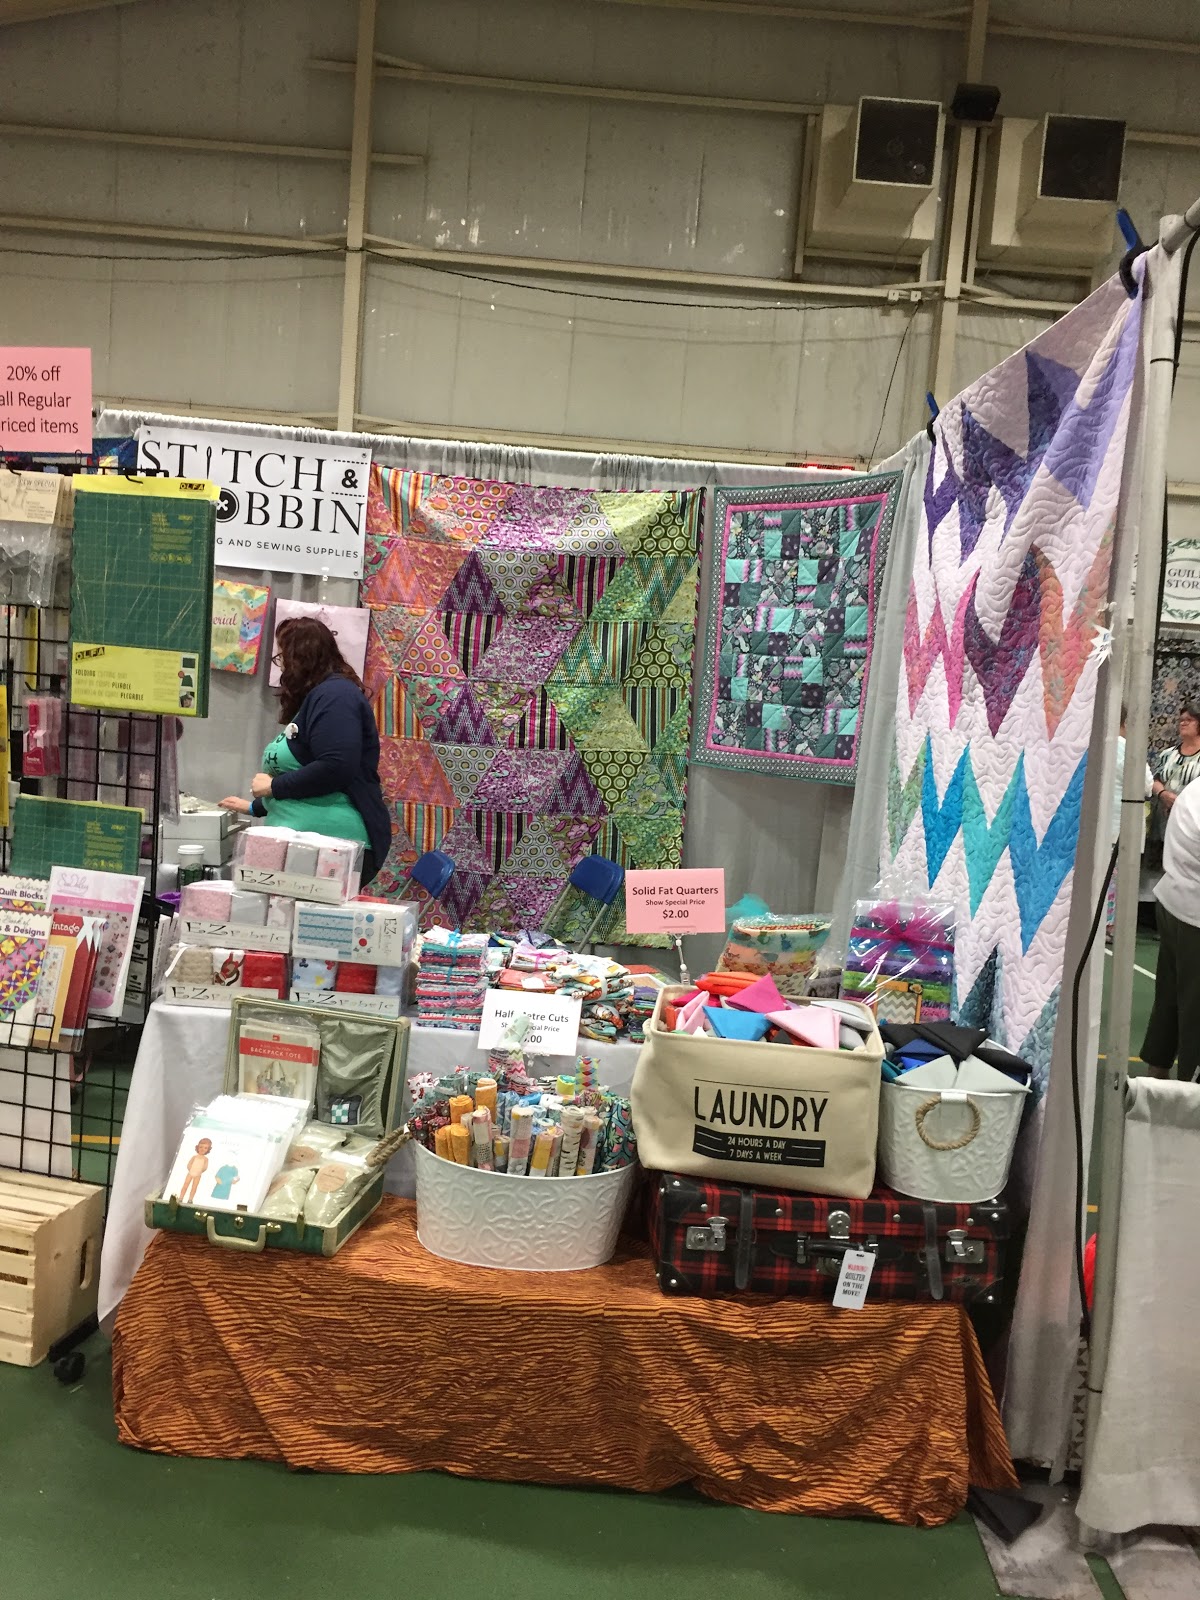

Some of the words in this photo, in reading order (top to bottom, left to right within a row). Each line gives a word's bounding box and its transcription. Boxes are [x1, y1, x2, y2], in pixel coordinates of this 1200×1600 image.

[7, 366, 37, 381] 20%
[41, 366, 61, 381] off
[0, 391, 13, 406] all
[19, 392, 71, 410] Regular
[1, 417, 36, 432] riced
[40, 418, 79, 434] items
[142, 440, 326, 492] STITCH
[341, 468, 359, 489] &
[217, 488, 364, 536] OBBIN
[228, 539, 252, 548] AND
[256, 541, 301, 553] SEWING
[306, 546, 359, 559] SUPPLIES
[1167, 568, 1200, 579] GUIL
[1166, 579, 1200, 589] STOR
[75, 646, 105, 662] OLFA
[75, 669, 96, 677] FOLDING
[112, 681, 131, 690] PLIABLE
[120, 692, 144, 701] PLEGABLE
[0, 888, 17, 897] Quilt
[20, 890, 44, 900] Blocks
[632, 886, 656, 896] Solid
[658, 887, 674, 895] Fat
[676, 886, 719, 896] Quarters
[662, 909, 689, 919] $2.00
[13, 926, 46, 937] Designs
[52, 922, 80, 934] intage
[495, 1009, 514, 1018] Half
[523, 1012, 546, 1021] etre
[548, 1013, 569, 1023] Cuts
[250, 1047, 284, 1057] BACKPACK
[694, 1086, 828, 1132] LAUNDRY
[727, 1136, 736, 1146] 24
[738, 1137, 764, 1148] HOURS
[766, 1140, 771, 1149] A
[773, 1140, 787, 1149] DAY
[729, 1149, 734, 1158] 7
[736, 1149, 753, 1159] DAYS
[756, 1152, 761, 1160] A
[764, 1152, 783, 1161] WEEK
[845, 1271, 866, 1282] QUILTER
[852, 1282, 864, 1290] THE
